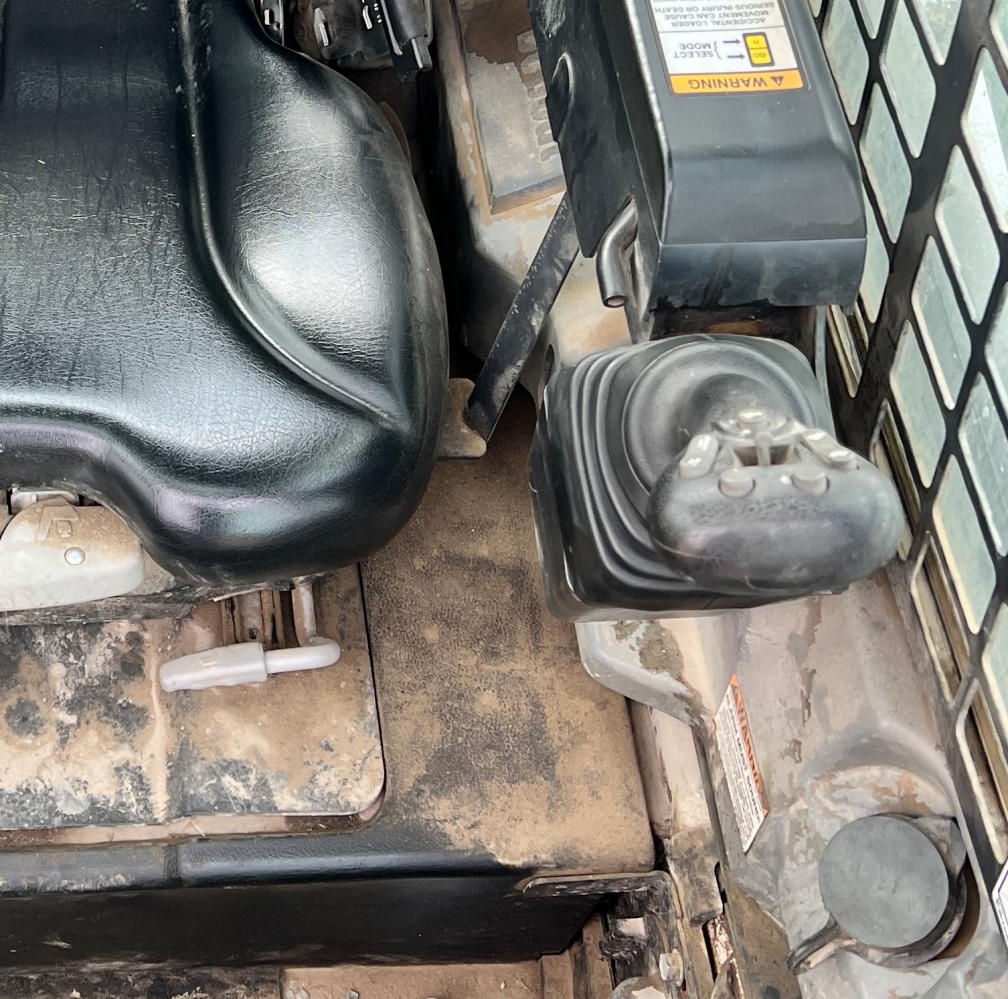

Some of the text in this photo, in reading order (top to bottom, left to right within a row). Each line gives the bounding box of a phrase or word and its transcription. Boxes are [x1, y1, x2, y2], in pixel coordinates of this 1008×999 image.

[710, 17, 766, 25] ACCIDENTAL
[671, 50, 713, 58] SELECT
[687, 76, 767, 90] WARNING
